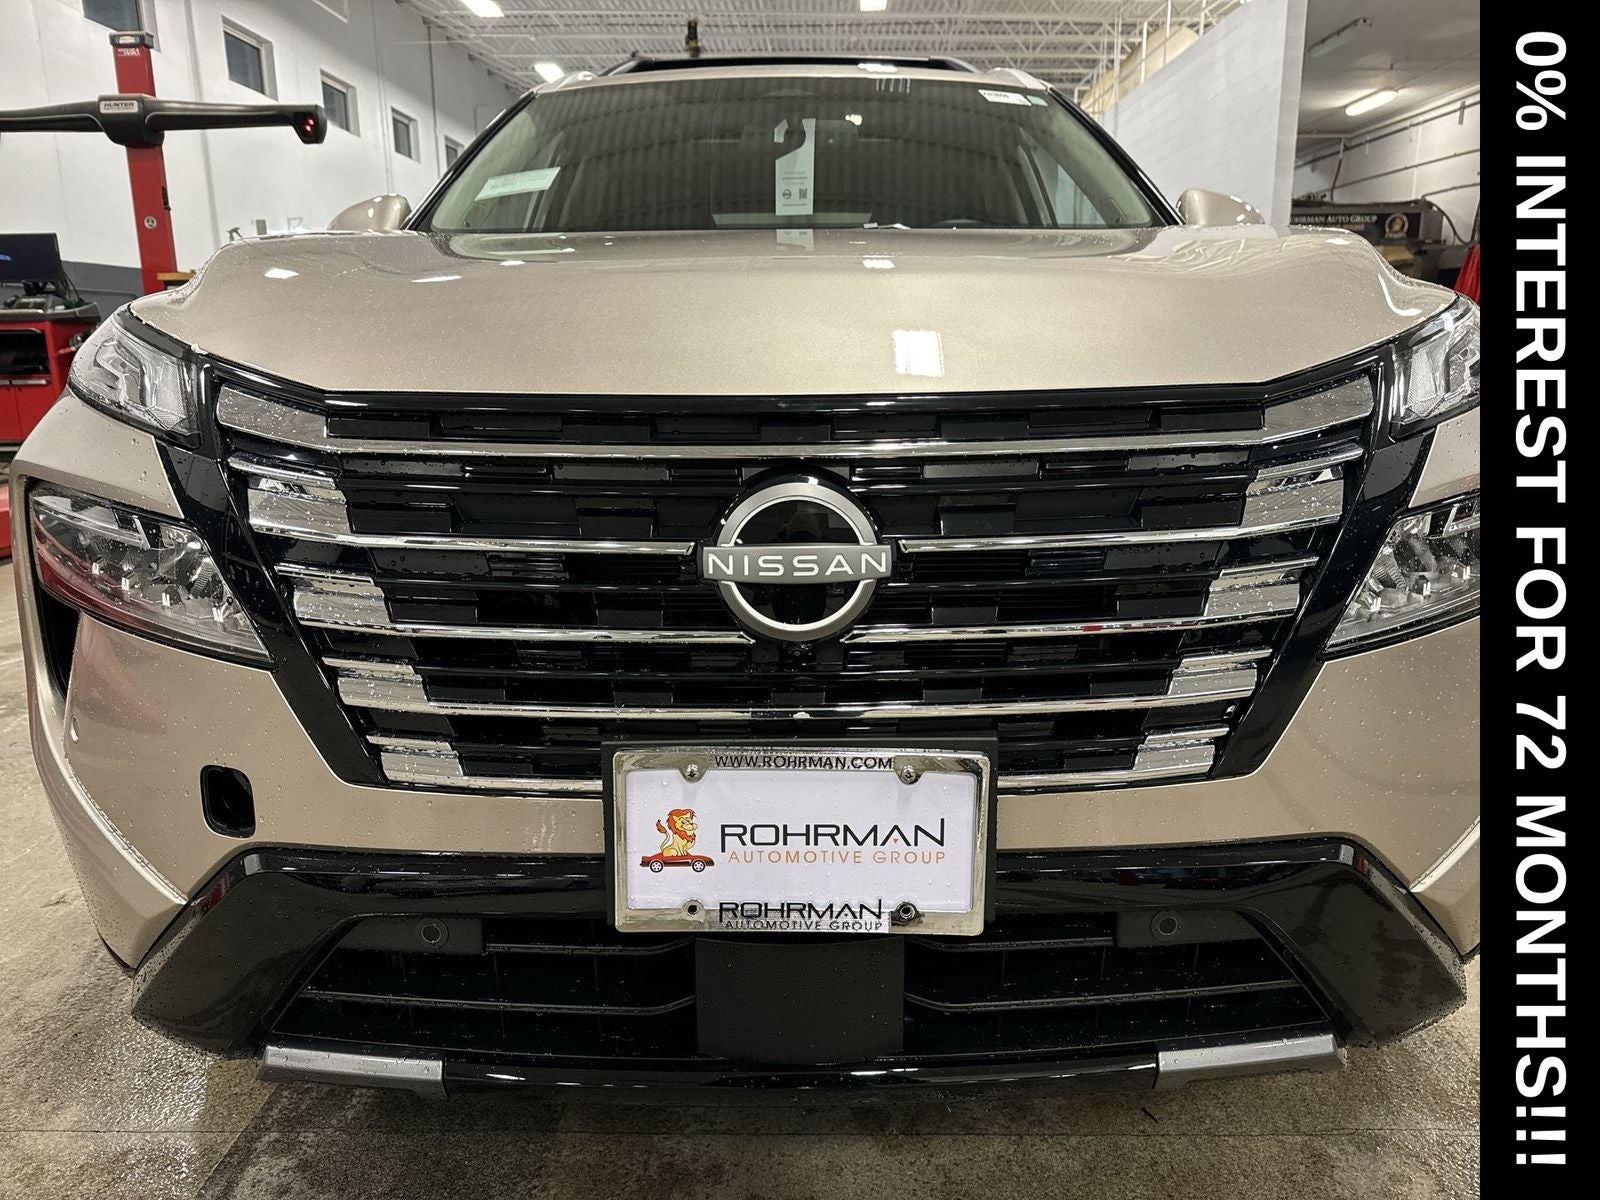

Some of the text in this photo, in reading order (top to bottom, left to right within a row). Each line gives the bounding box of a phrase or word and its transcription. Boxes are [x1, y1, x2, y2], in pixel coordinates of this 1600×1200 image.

[1327, 214, 1349, 224] AUTO
[1350, 214, 1378, 224] GROUP
[707, 551, 887, 577] NISSAN
[714, 755, 893, 770] WWW.ROHRMAN.COM
[720, 817, 945, 853] ROHRMAN
[728, 850, 946, 864] AUTOMOTIVE GROUP
[719, 897, 882, 923] ROHRMAN
[724, 920, 882, 932] AUTOMOTIVE GROUP
